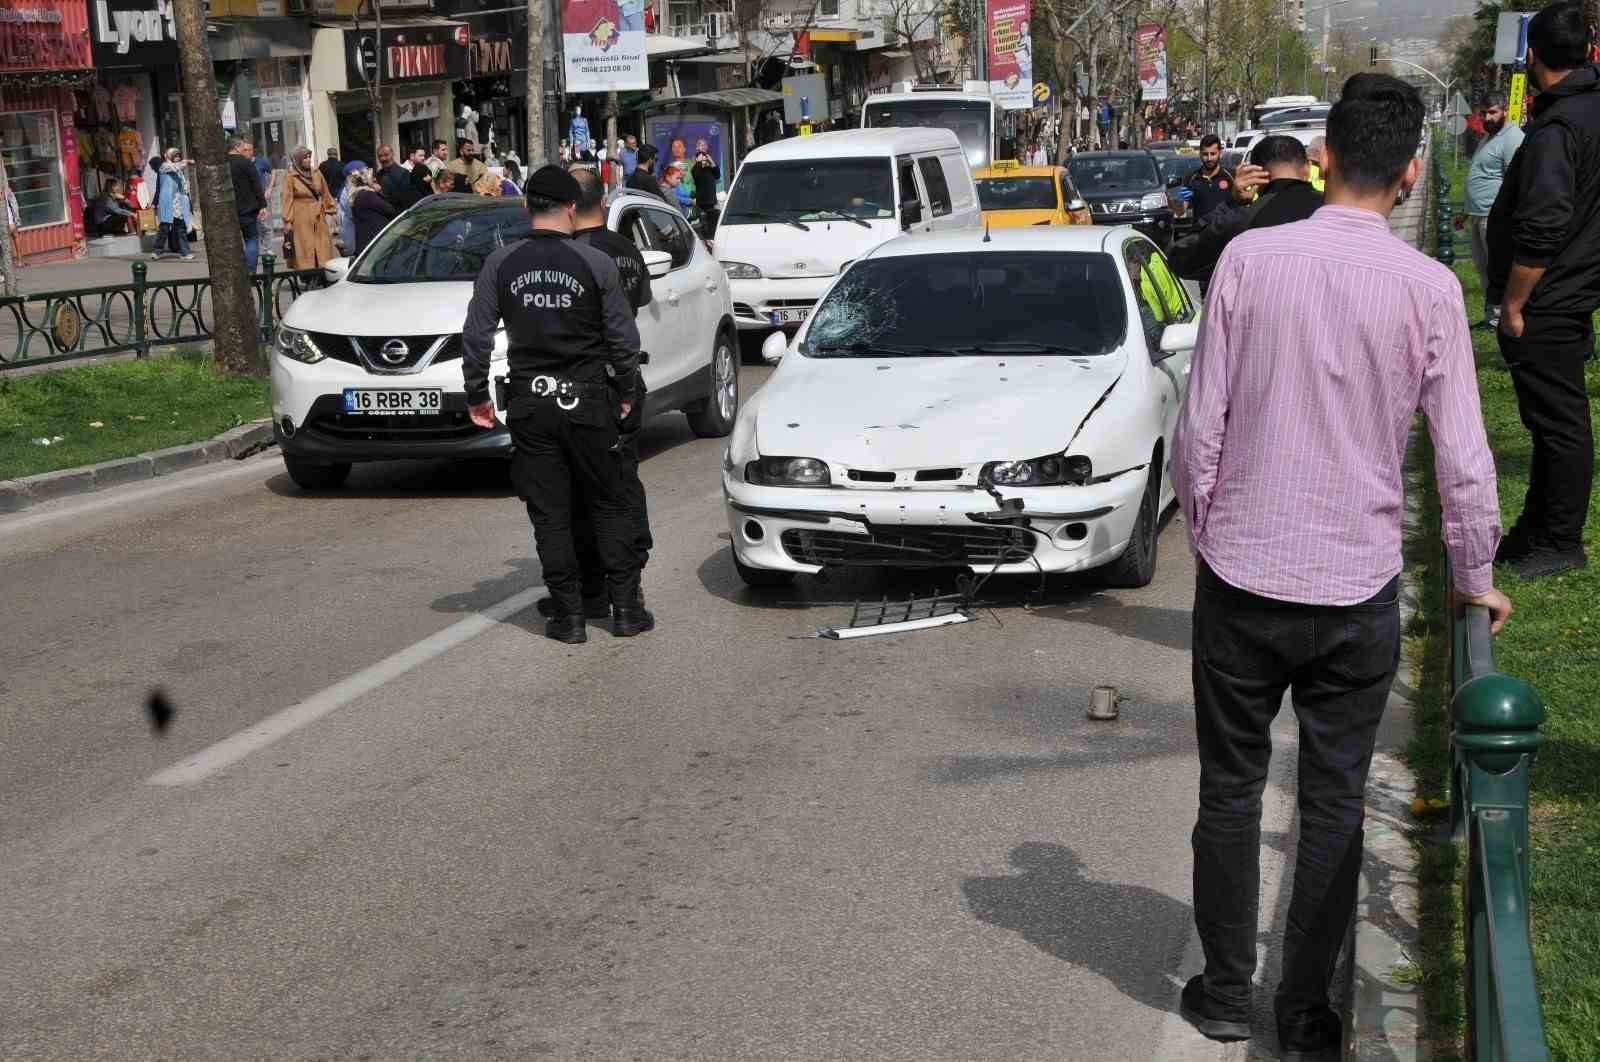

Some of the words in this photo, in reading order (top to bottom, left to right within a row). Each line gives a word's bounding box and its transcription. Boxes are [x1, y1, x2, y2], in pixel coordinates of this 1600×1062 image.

[544, 270, 585, 297] KUVVET
[354, 392, 372, 409] 16
[377, 392, 412, 408] RBR
[419, 391, 439, 408] 38
